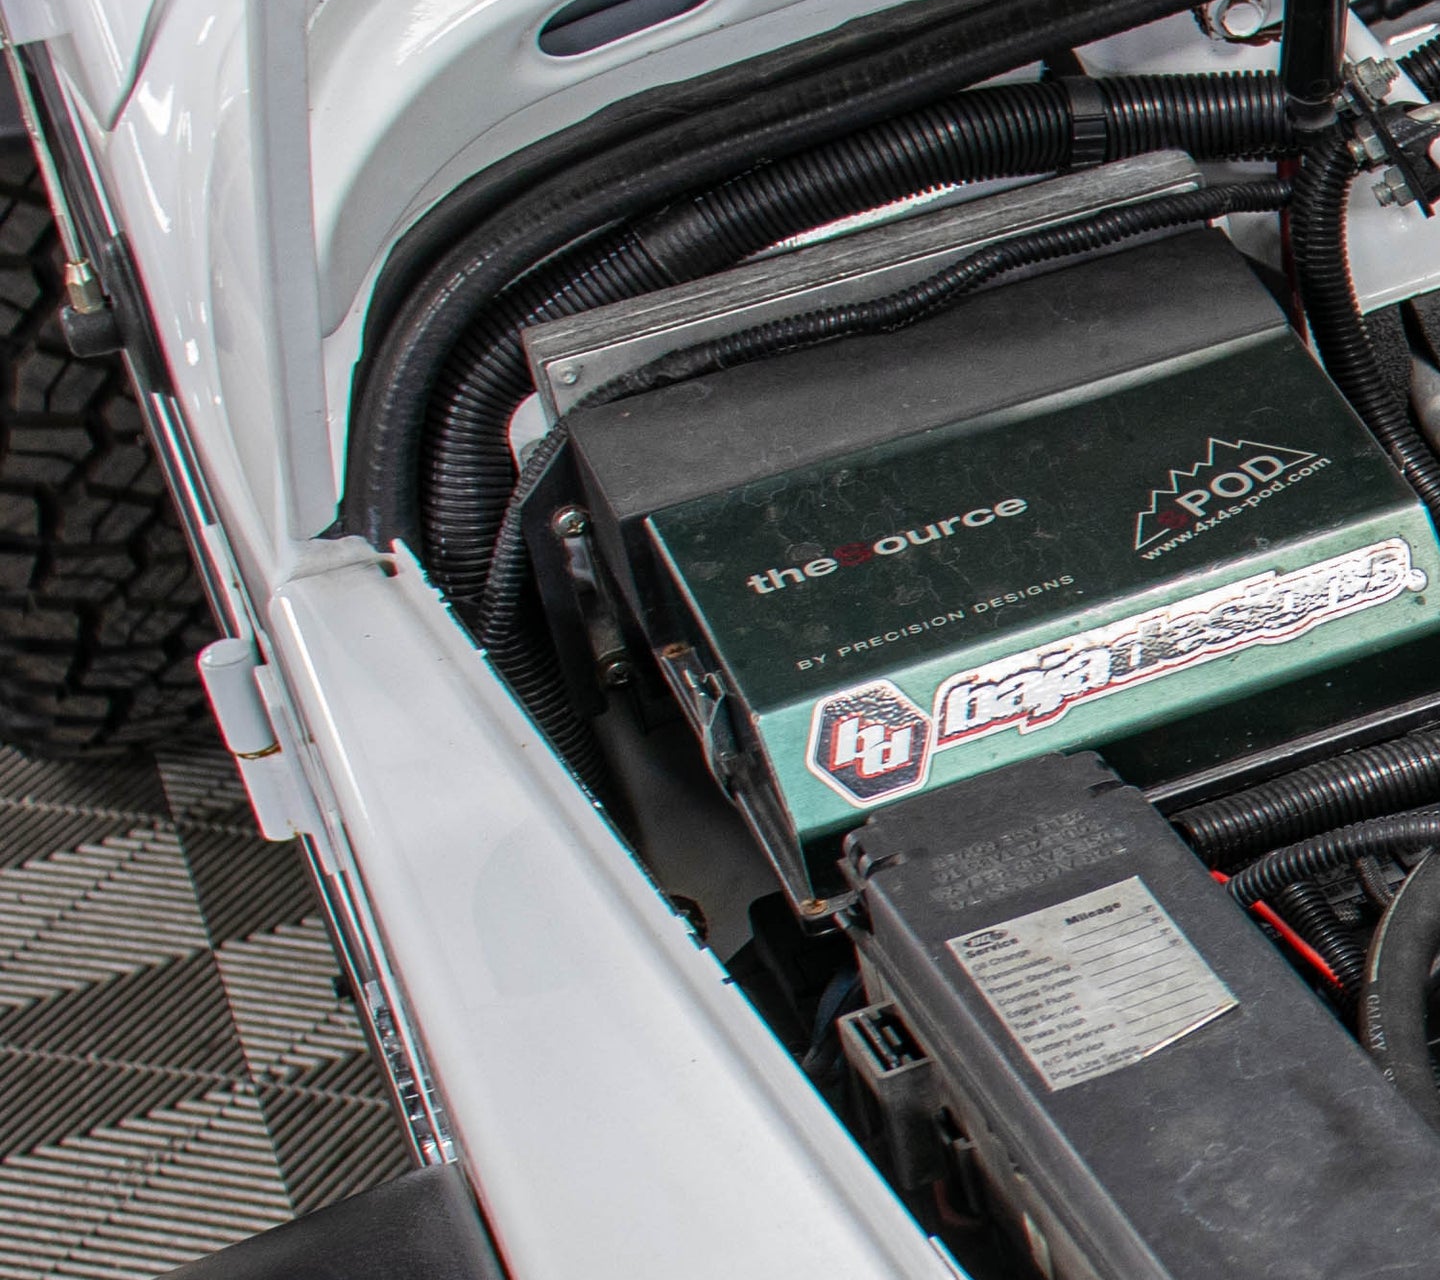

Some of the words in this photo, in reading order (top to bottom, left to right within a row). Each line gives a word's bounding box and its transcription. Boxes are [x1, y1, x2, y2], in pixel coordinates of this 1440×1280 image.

[1140, 456, 1333, 561] www.4x4s-pod.com
[796, 652, 827, 671] BY
[837, 610, 965, 658] PRECISION
[974, 574, 1075, 615] DESIGNS
[1064, 901, 1122, 926] Mileage
[965, 937, 1019, 959] Service
[1366, 993, 1388, 1052] GALAXY
